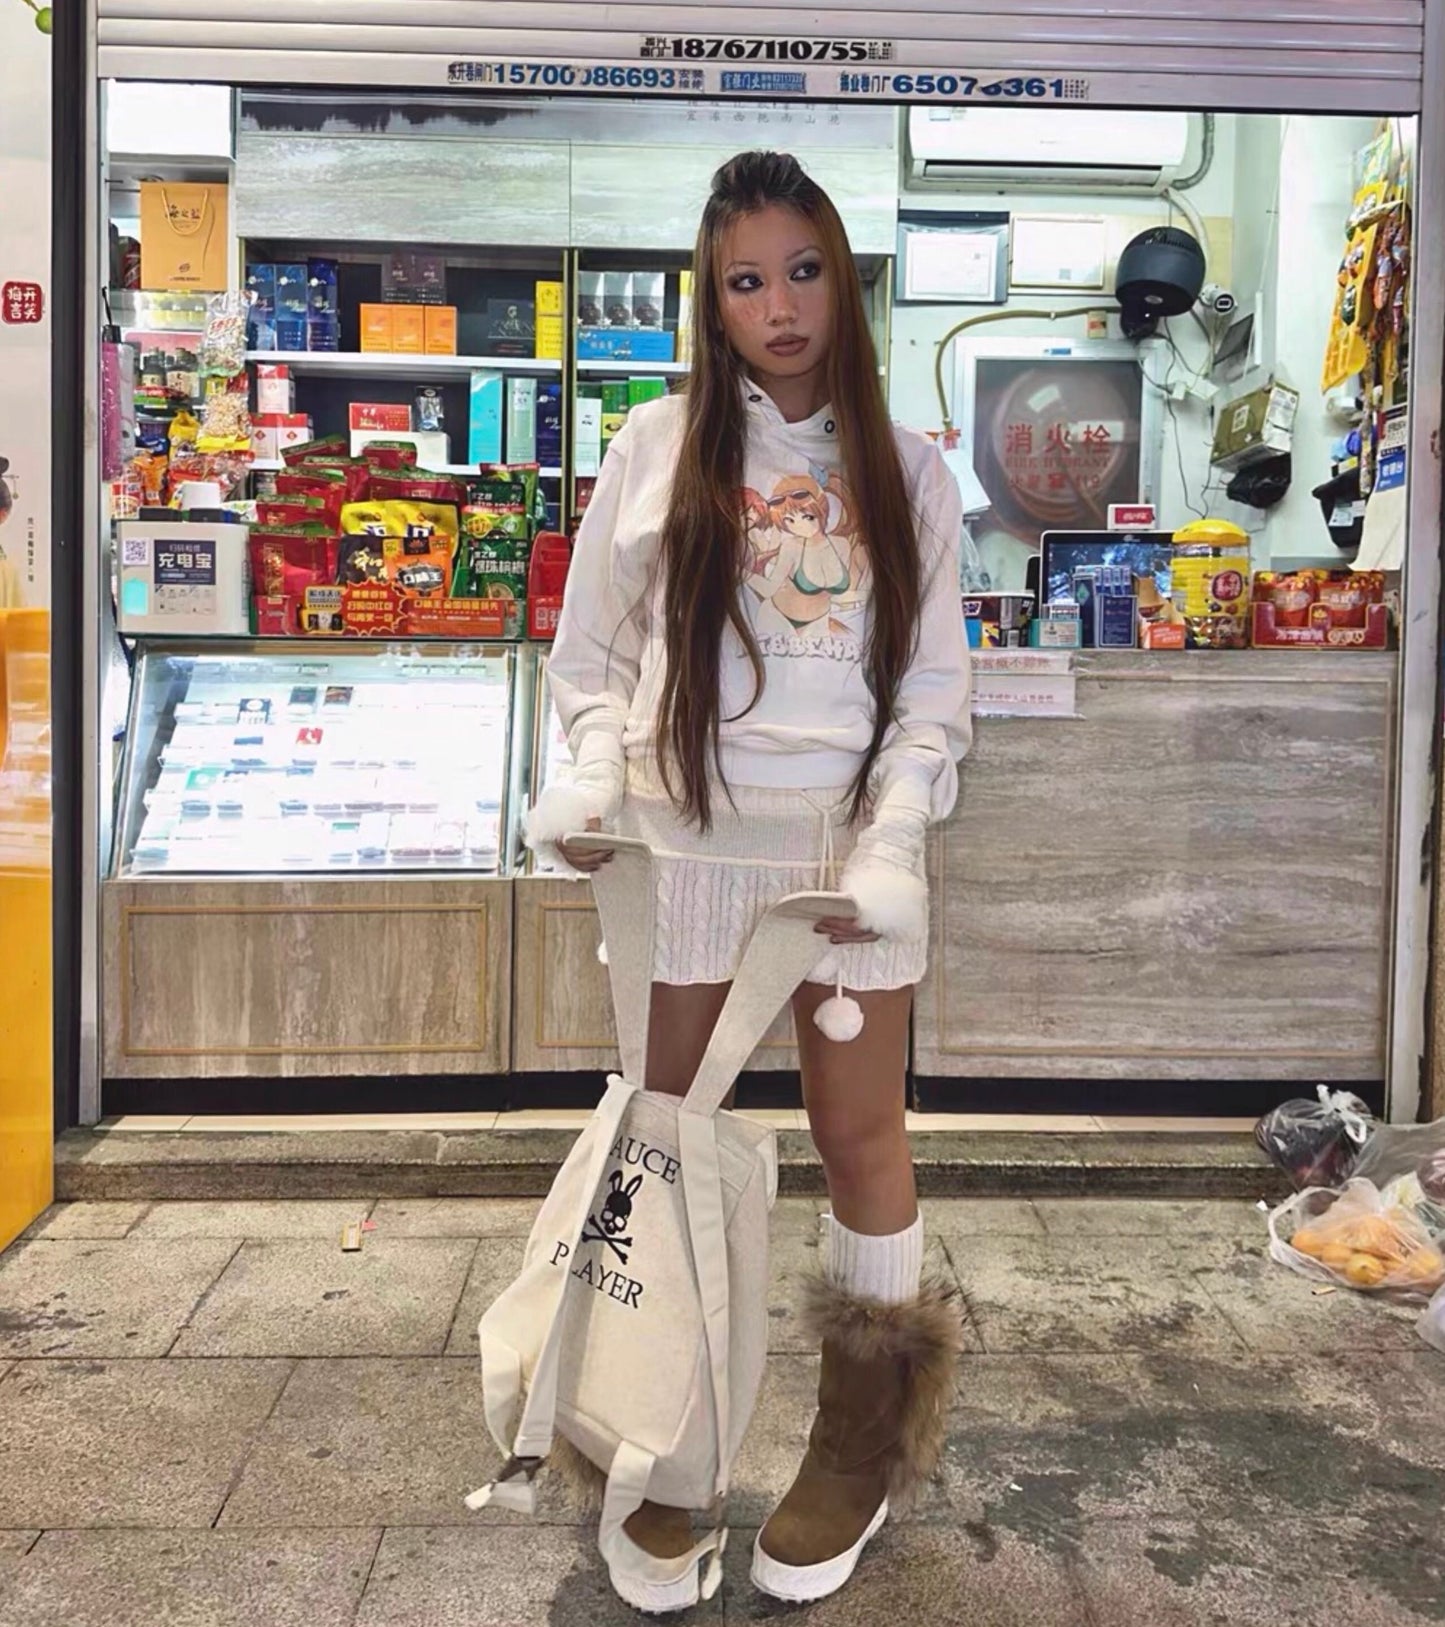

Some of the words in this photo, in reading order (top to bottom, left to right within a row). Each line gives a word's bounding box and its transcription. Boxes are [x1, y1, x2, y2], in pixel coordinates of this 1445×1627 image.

[671, 38, 868, 61] 18767110755
[1005, 423, 1111, 455] 消火栓
[158, 552, 213, 569] 充电宝
[610, 1136, 681, 1185] AUCE
